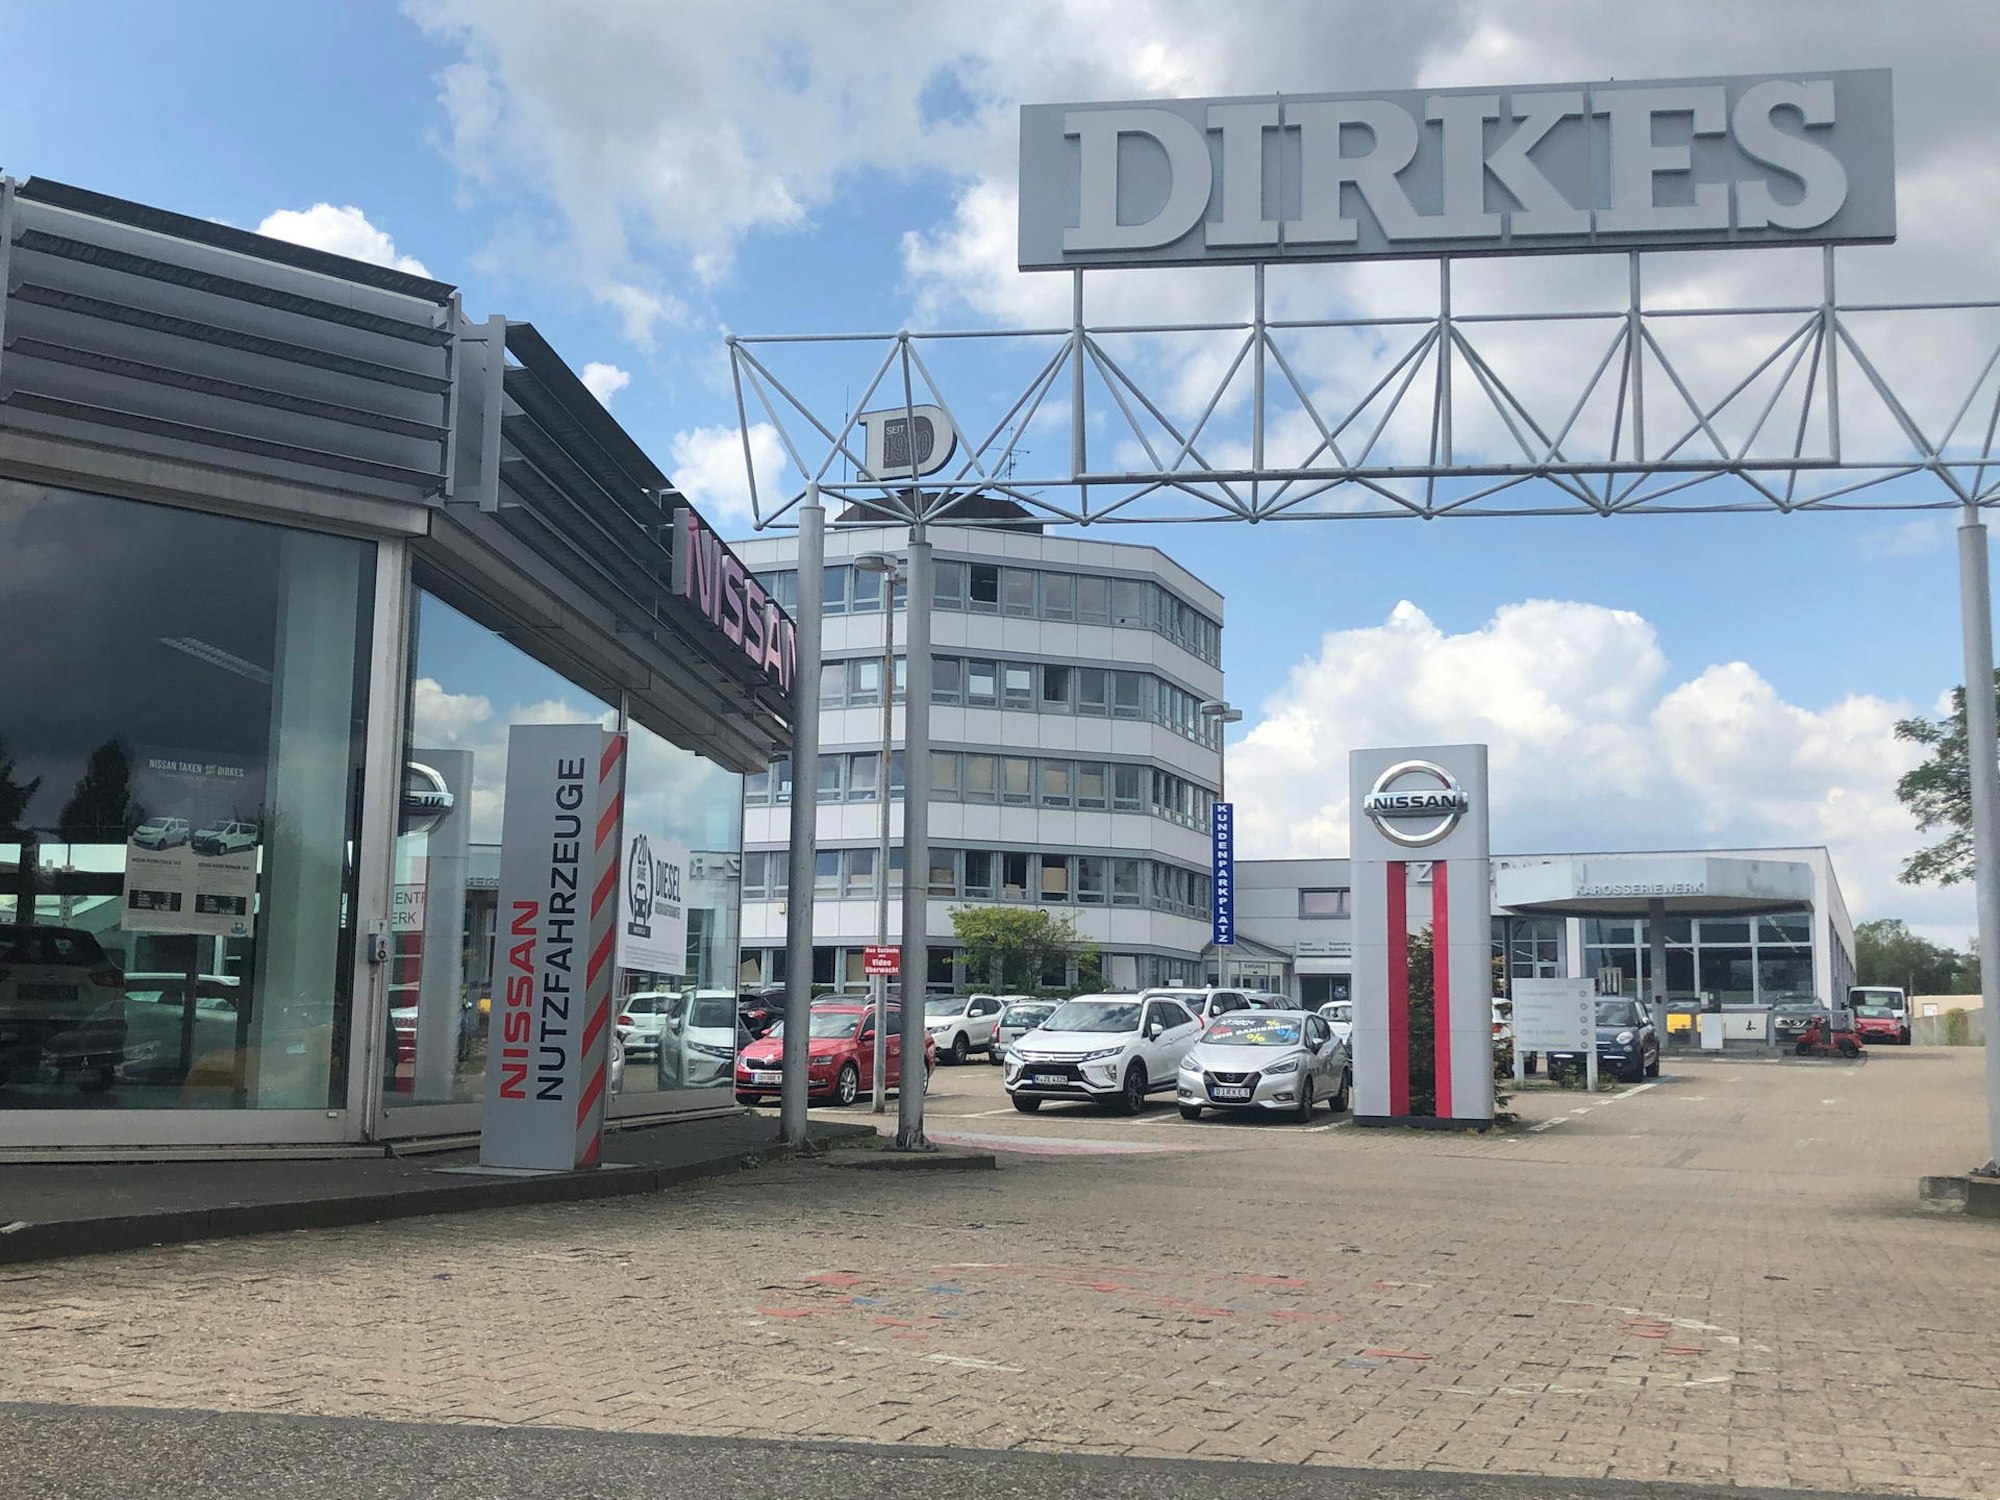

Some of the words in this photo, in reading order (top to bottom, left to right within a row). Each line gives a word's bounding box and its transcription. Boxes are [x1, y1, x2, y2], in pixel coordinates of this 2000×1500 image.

[1062, 79, 1848, 254] DIRKES
[885, 430, 932, 462] 190
[886, 425, 905, 435] SEIT
[150, 759, 177, 771] NISSAN
[217, 766, 244, 777] DIRKES
[1374, 795, 1457, 809] NISSAN
[655, 860, 681, 902] DIESEL
[1217, 804, 1229, 943] KUNDENPARKPLATZ
[537, 757, 585, 1100] NUTZFAHRZEUGE
[500, 901, 539, 1099] NISSAN
[1215, 1087, 1249, 1098] DIRKES
